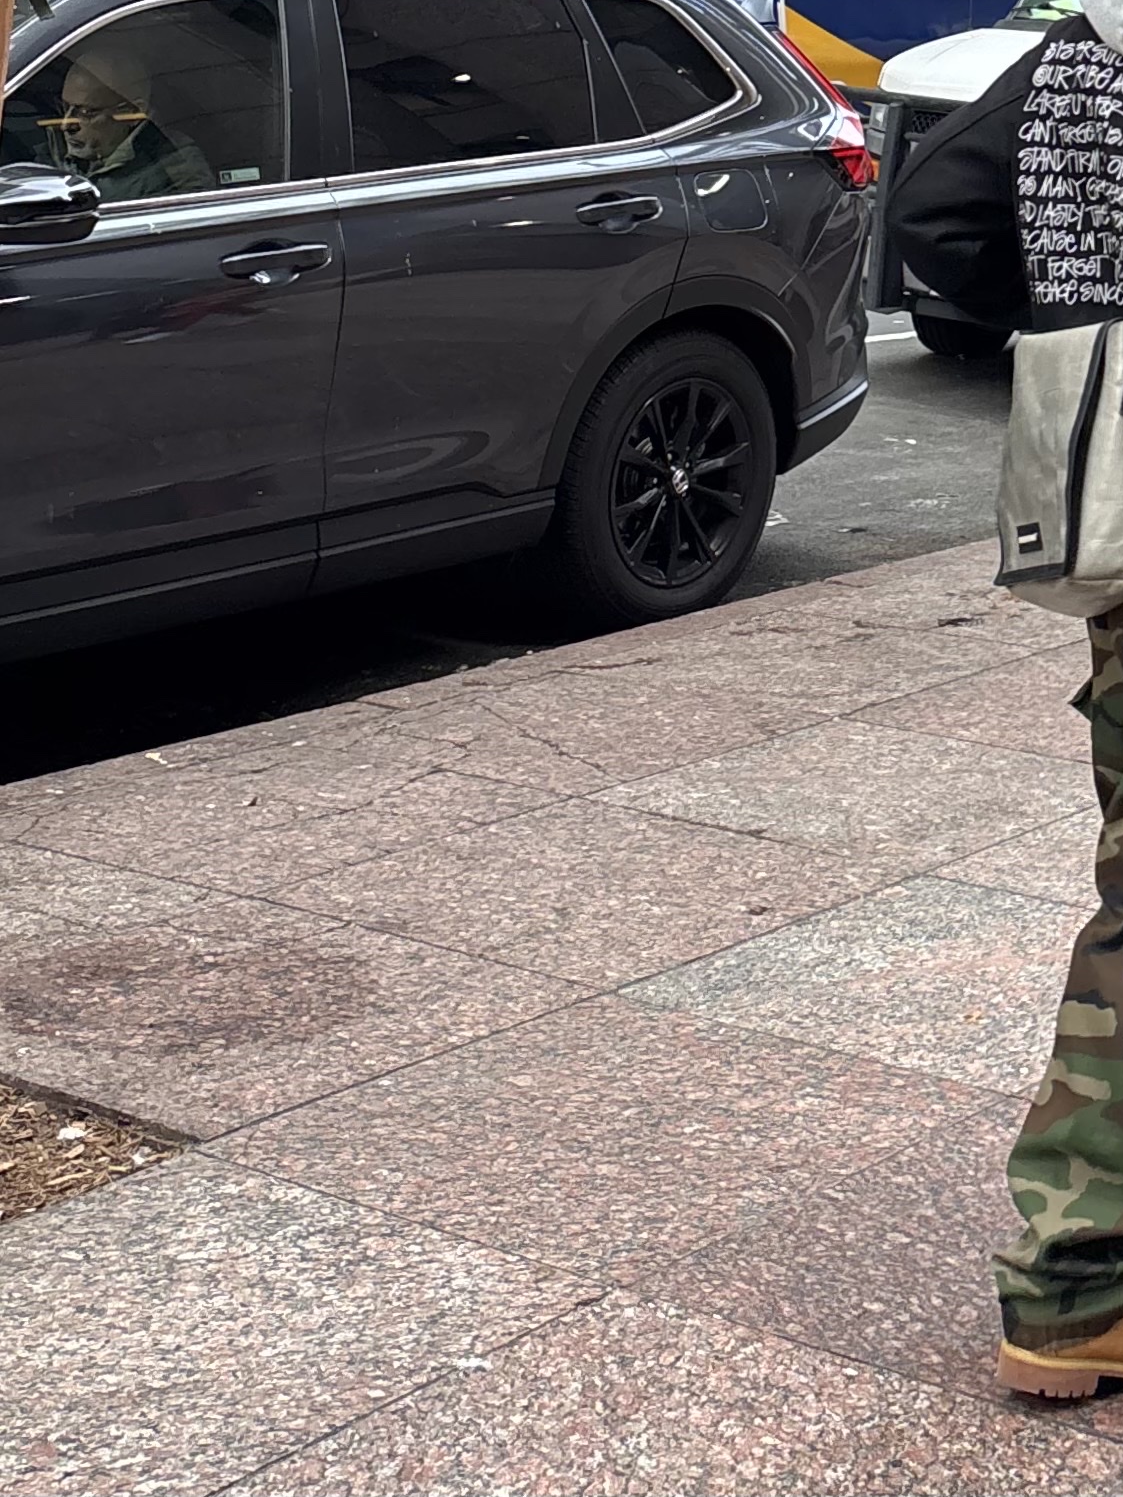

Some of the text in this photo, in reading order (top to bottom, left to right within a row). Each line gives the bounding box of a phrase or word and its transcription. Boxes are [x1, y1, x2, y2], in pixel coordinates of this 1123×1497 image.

[1037, 174, 1087, 202] MANY
[1080, 230, 1096, 251] IN
[1046, 254, 1110, 281] FORGET
